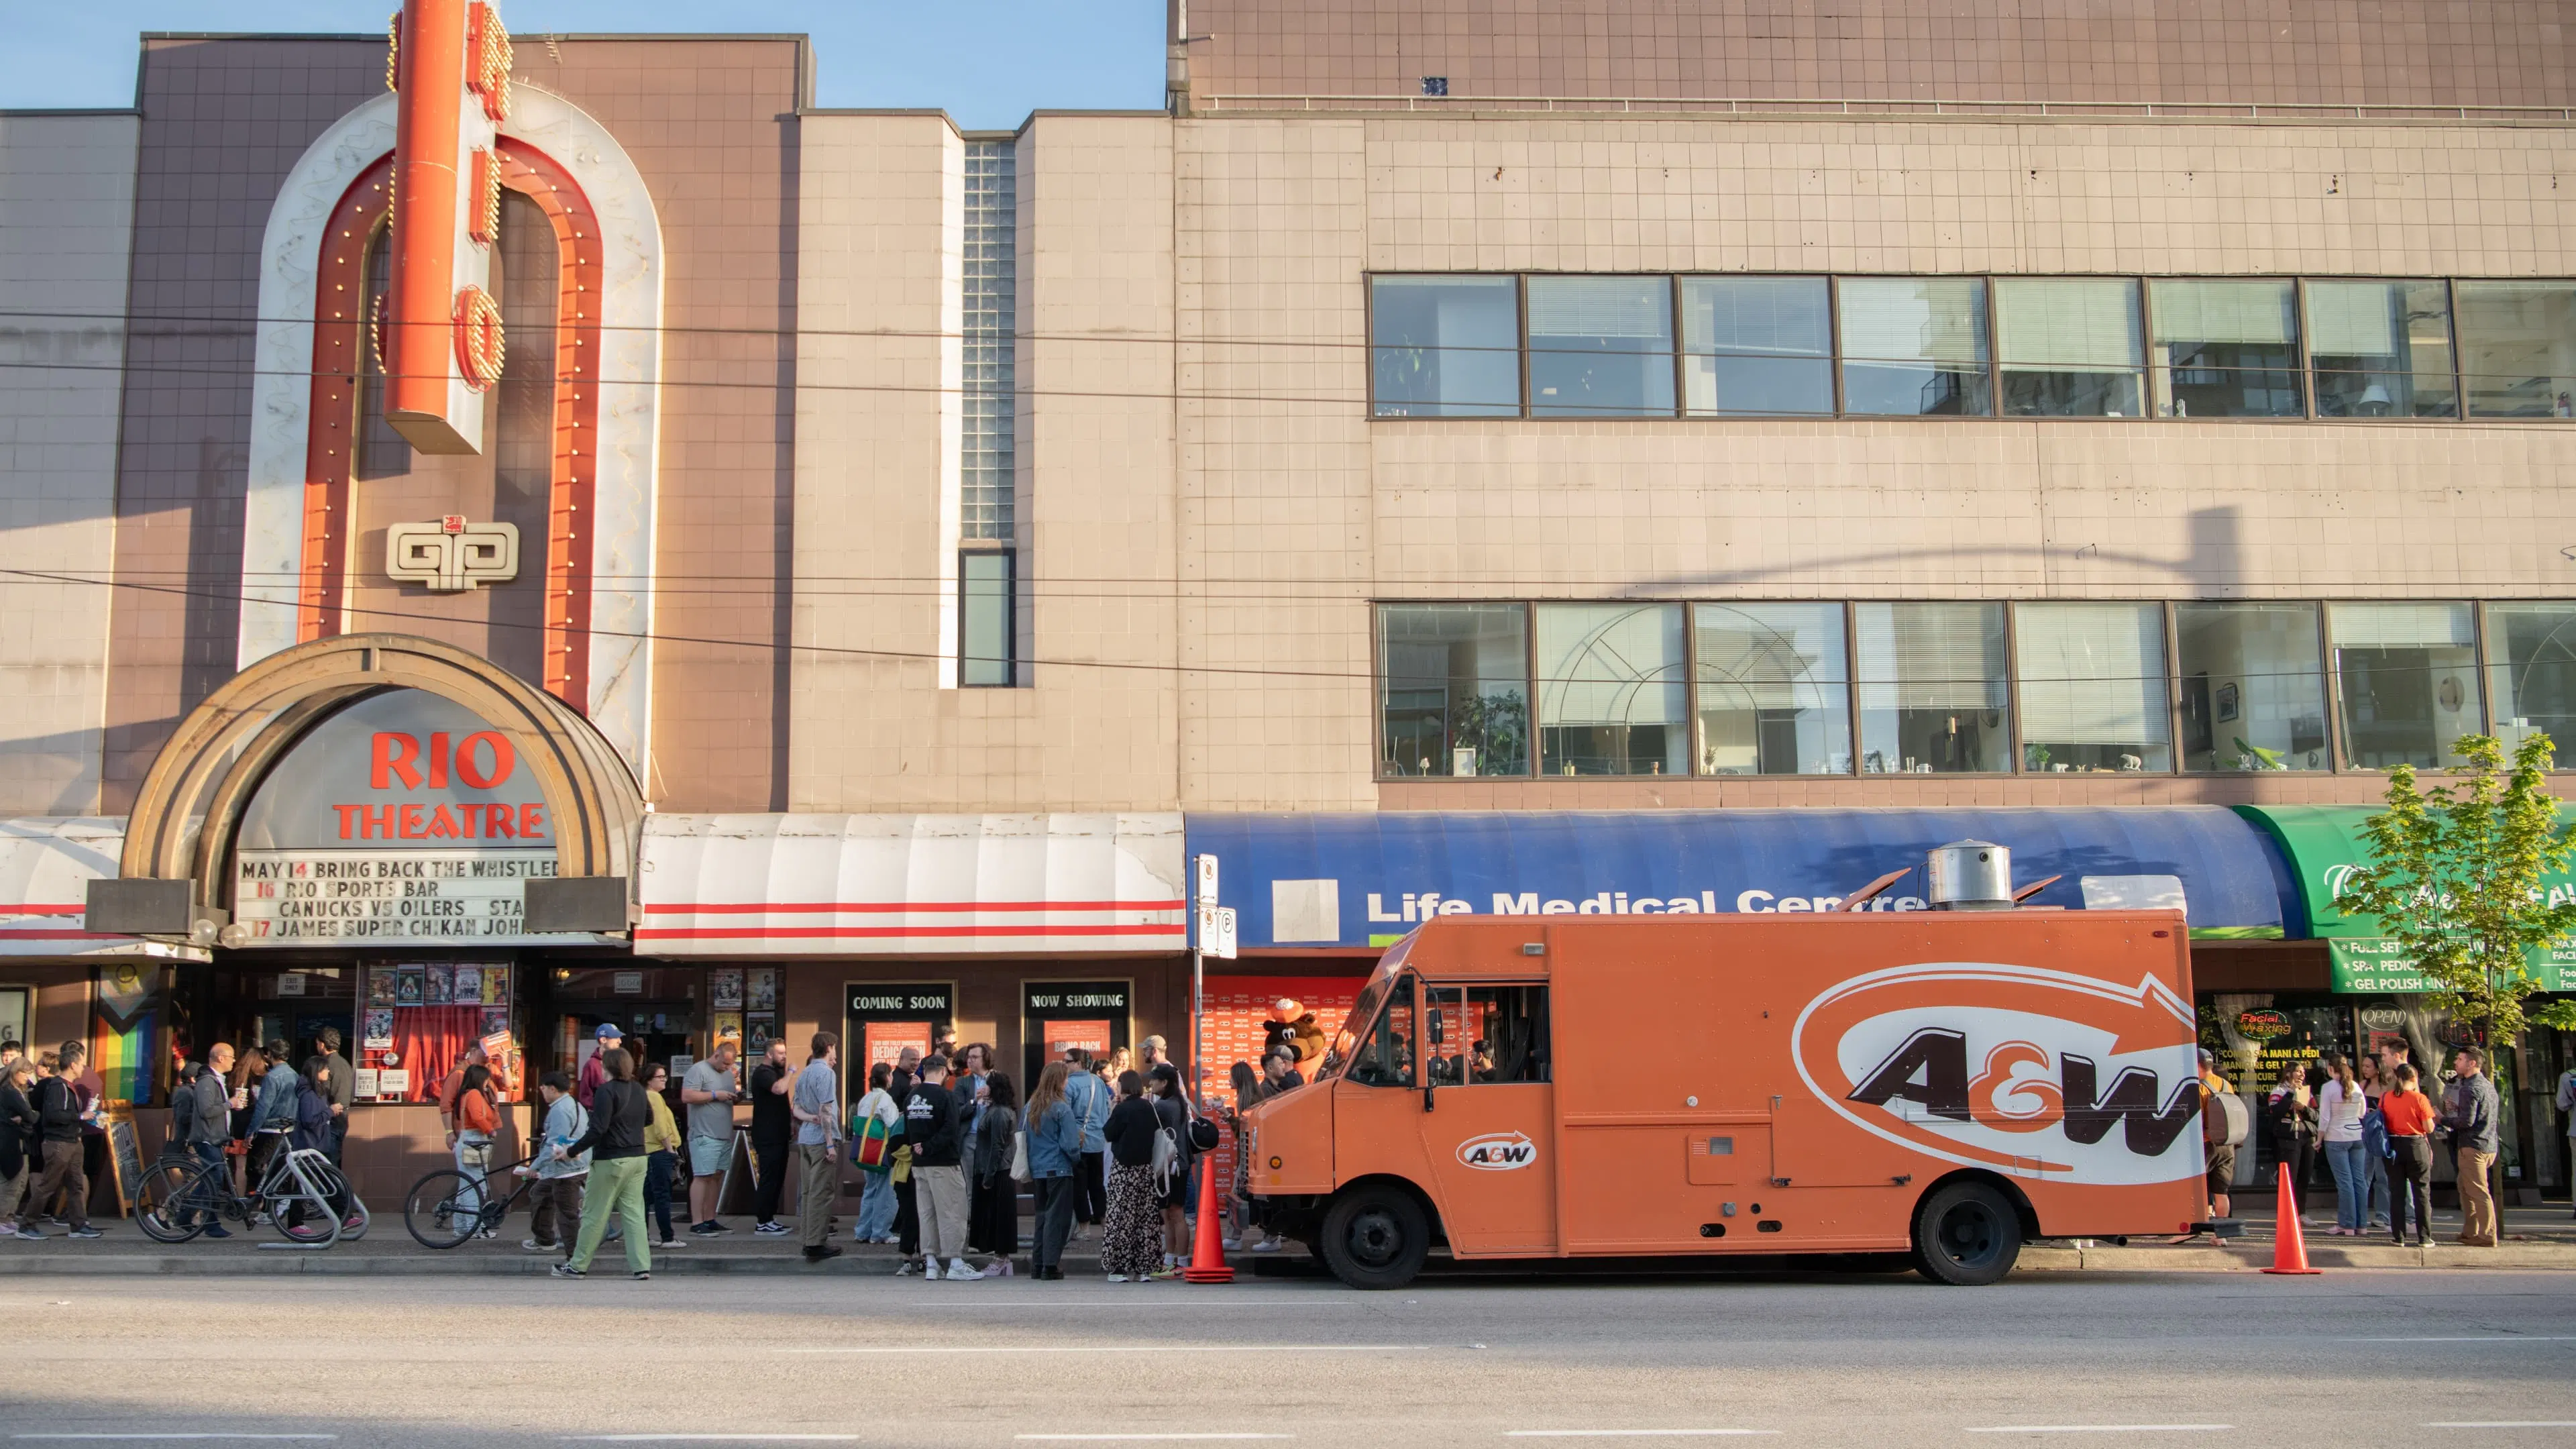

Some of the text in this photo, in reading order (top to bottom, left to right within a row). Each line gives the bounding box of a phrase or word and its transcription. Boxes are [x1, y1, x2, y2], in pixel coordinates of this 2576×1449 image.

[370, 731, 515, 791] RIO
[333, 802, 545, 840] THEATRE
[242, 862, 282, 878] MAY
[288, 861, 307, 878] 14
[315, 861, 370, 878] BRING
[378, 861, 424, 877] BACK
[432, 861, 466, 877] THE
[258, 880, 439, 898] 16 RIO SPORTS BAR
[279, 900, 362, 917] CANUCKS
[370, 900, 393, 916] VS
[400, 900, 465, 916] OILERS
[1367, 893, 1472, 922] Life
[1493, 890, 1716, 914] Medical
[252, 920, 270, 937] 17
[276, 920, 338, 937] JAMES
[343, 920, 404, 936] SUPER
[410, 919, 476, 936] CHIKAN
[2380, 942, 2401, 953] SET
[2355, 978, 2377, 989] GEL
[2379, 978, 2423, 989] POLISH
[853, 996, 945, 1010] COMING SOON
[1030, 994, 1124, 1008] NOW SHOWING
[2241, 1014, 2279, 1023] Facial
[2365, 1010, 2402, 1024] OPEN
[2243, 1024, 2292, 1035] Waxing
[873, 1046, 926, 1058] DEDICN
[1079, 1040, 1101, 1052] BACK
[2269, 1049, 2291, 1057] MANI
[2294, 1049, 2300, 1057] &
[2302, 1049, 2320, 1058] PEDI
[2265, 1061, 2281, 1069] GEL
[1845, 1026, 2202, 1157] A&W
[1468, 1146, 1531, 1163] A&W
